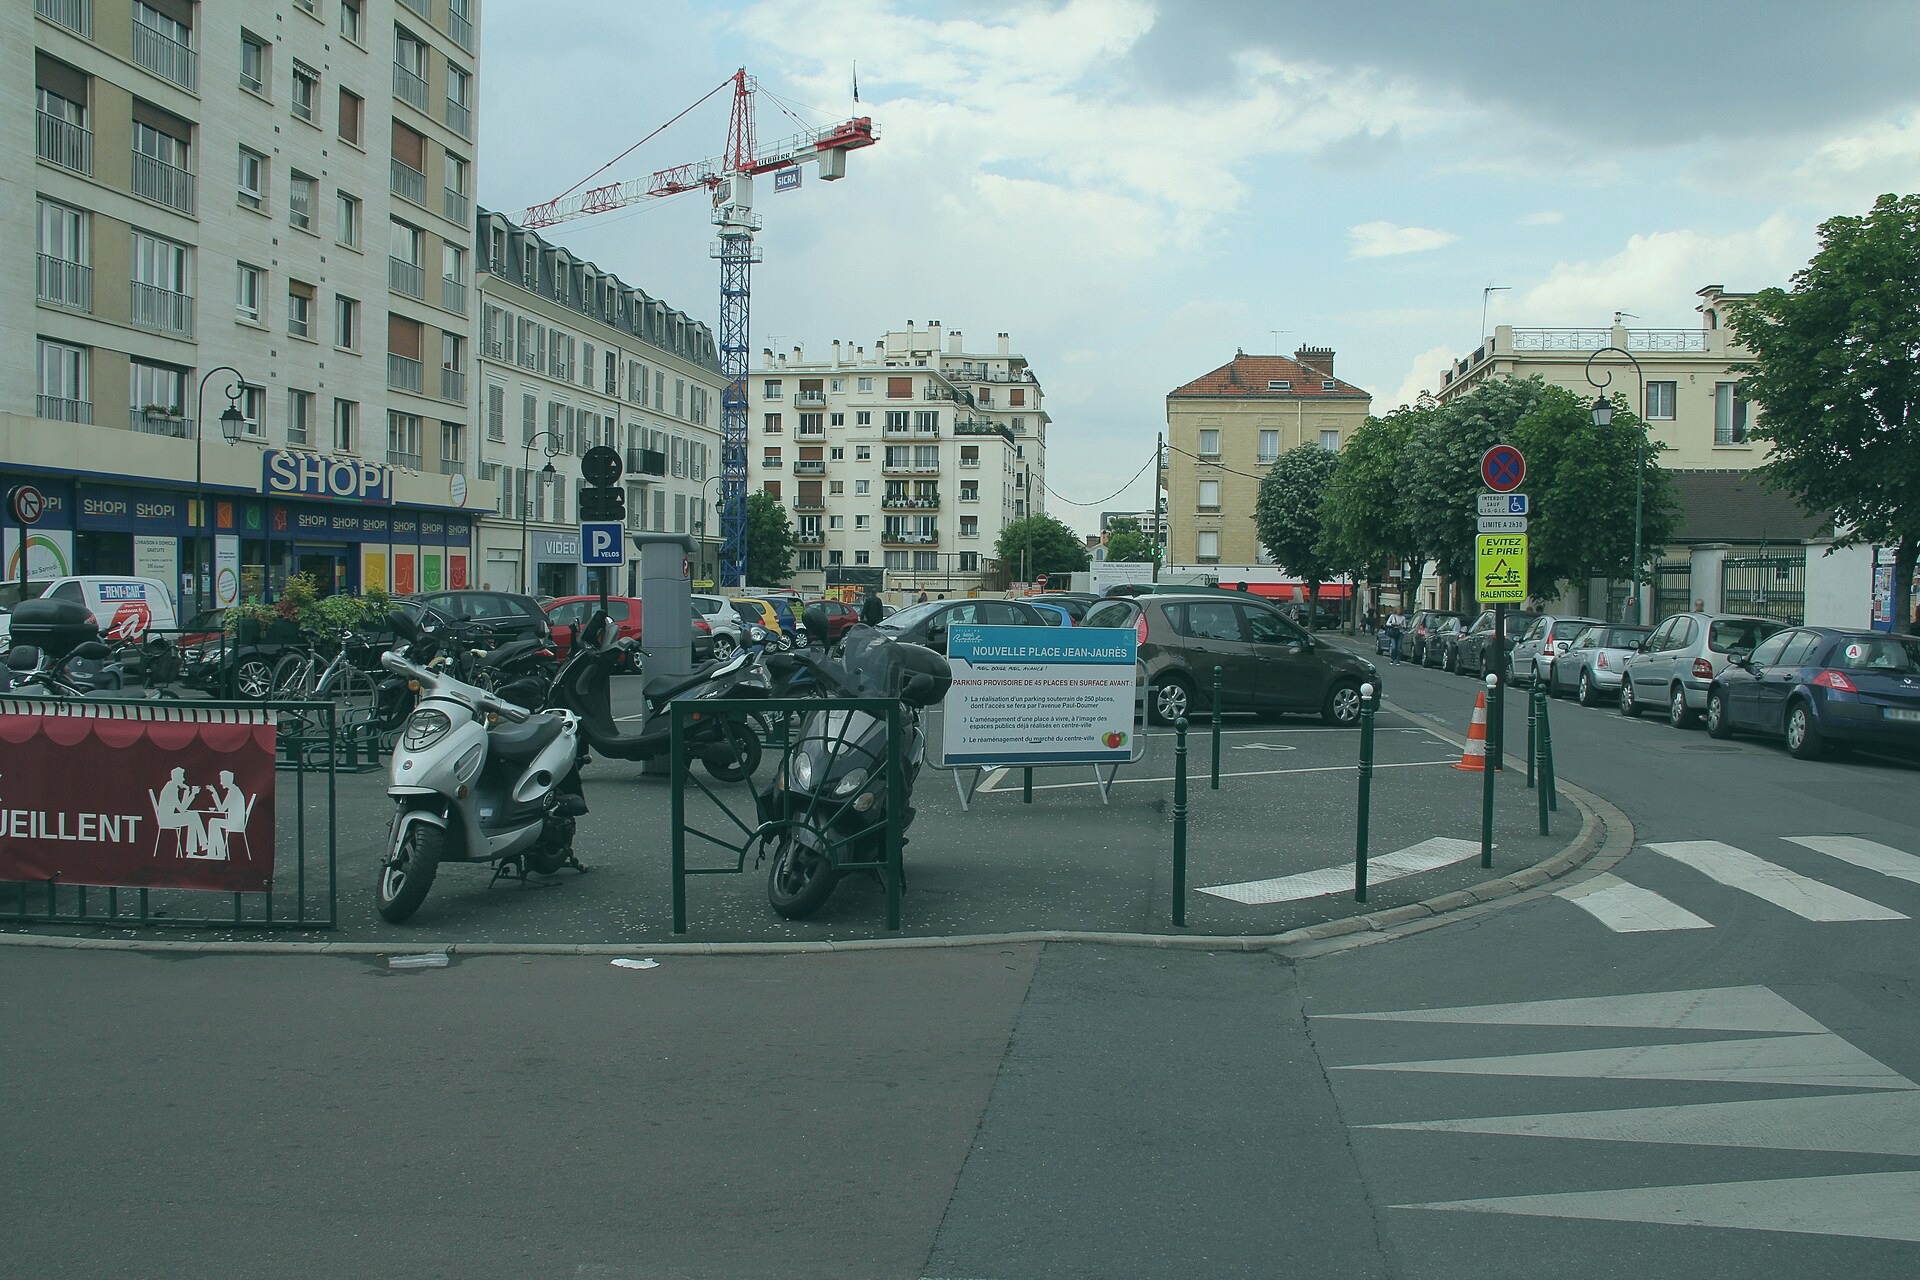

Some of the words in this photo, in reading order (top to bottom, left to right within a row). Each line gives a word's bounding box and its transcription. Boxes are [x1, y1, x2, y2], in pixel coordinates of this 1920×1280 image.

[778, 174, 797, 186] SICRA
[270, 453, 389, 498] SHOPI
[84, 498, 126, 514] SHOPI
[136, 503, 174, 516] SHOPI
[298, 514, 326, 526] SHOPI
[332, 517, 358, 528] SHOPI
[363, 519, 387, 530] SHOPI
[393, 520, 416, 532] SHOPI
[422, 522, 443, 533] SHOPI
[448, 524, 468, 534] SHOPI
[546, 540, 576, 554] VIDEO
[592, 530, 612, 557] P
[106, 586, 123, 598] RENT
[126, 586, 140, 598] CAR
[972, 646, 1026, 656] NOUVELLE
[1028, 647, 1060, 657] PLACE
[1062, 646, 1128, 658] JEAN-JAURÈS
[1849, 646, 1857, 656] A
